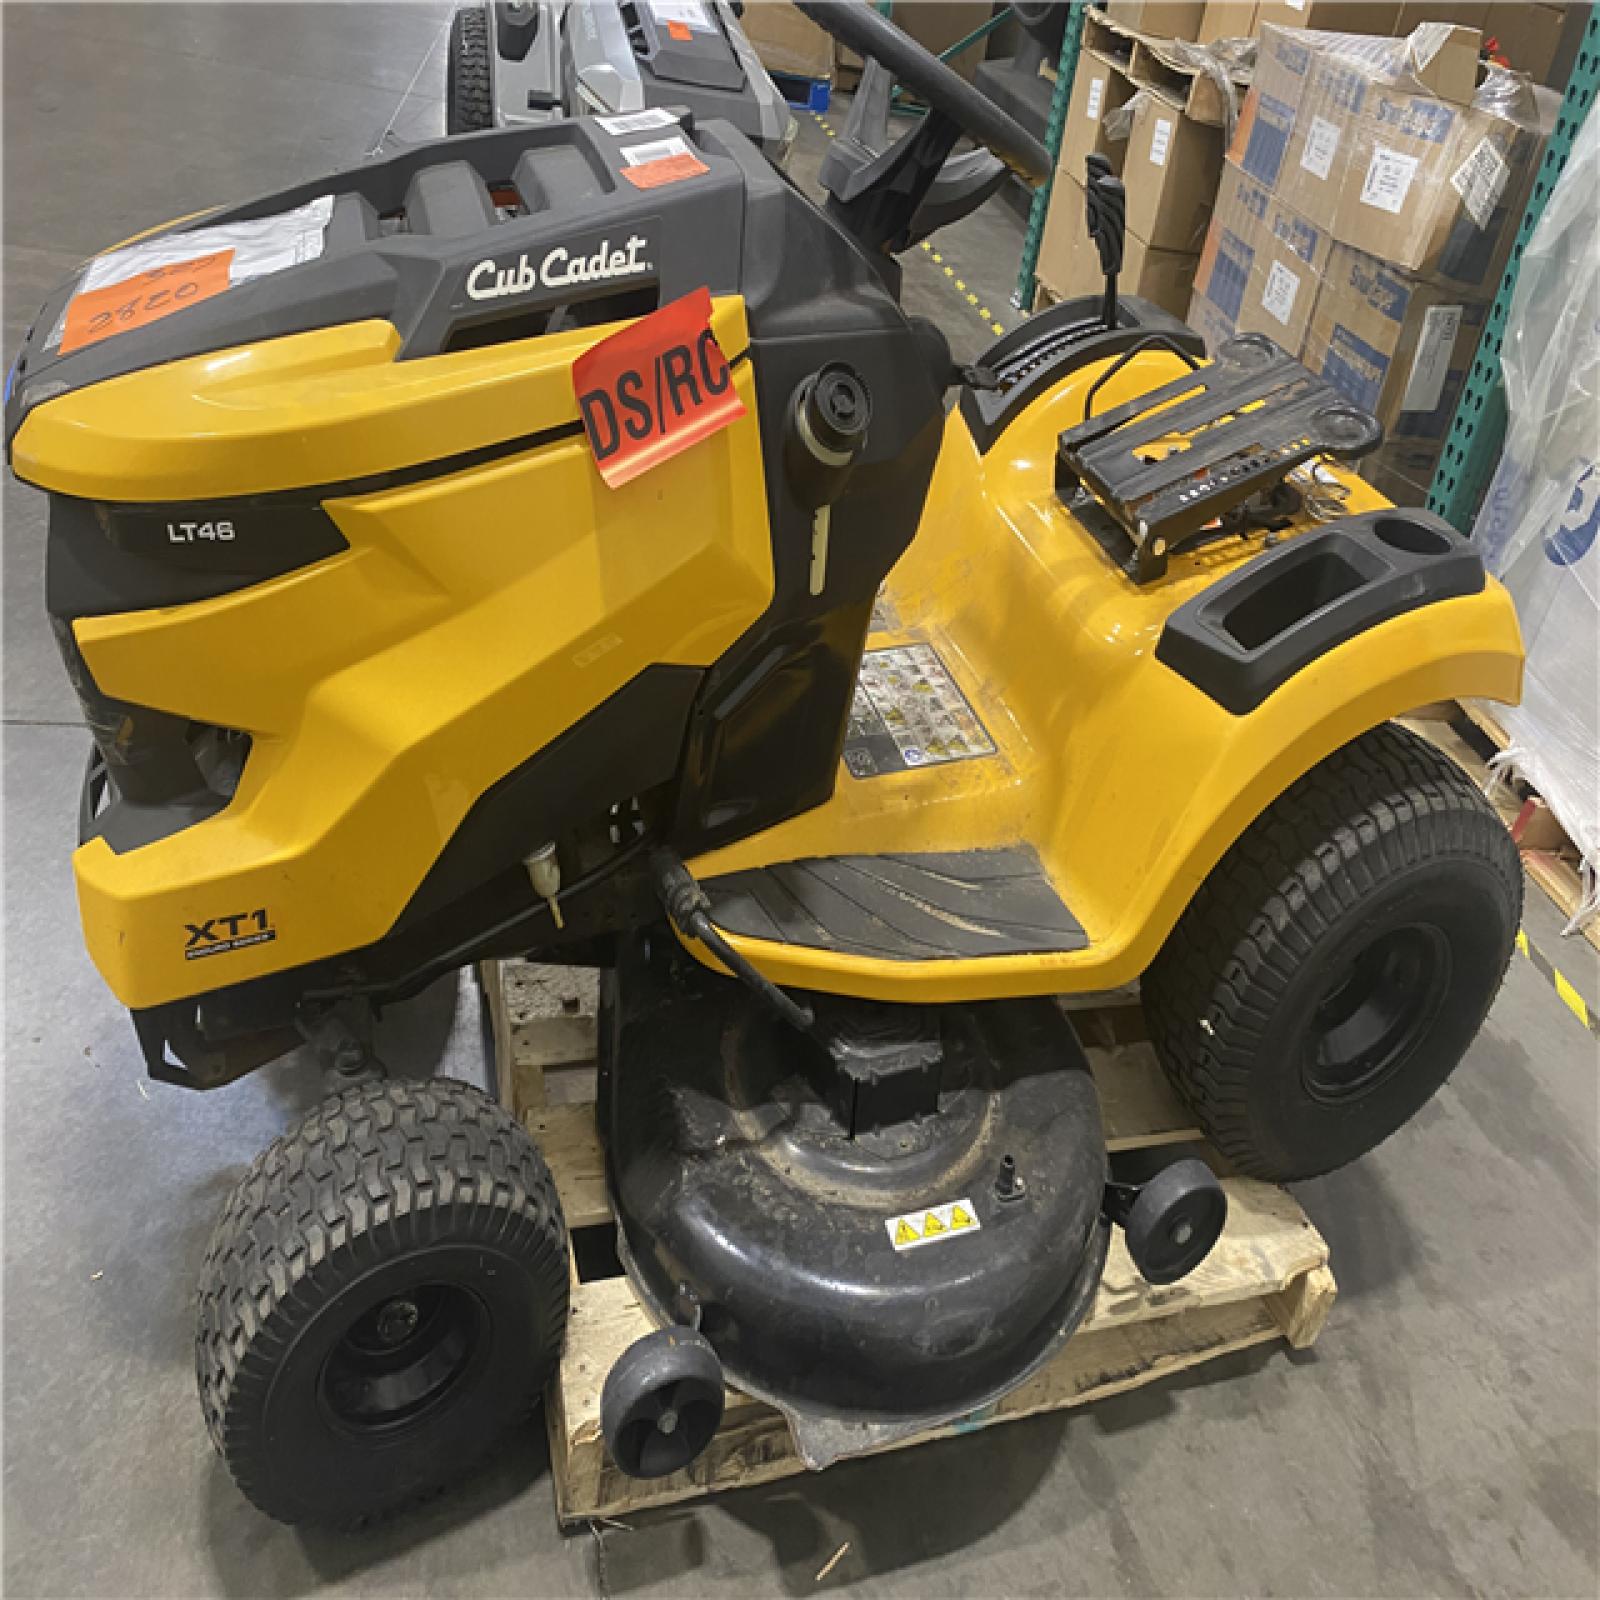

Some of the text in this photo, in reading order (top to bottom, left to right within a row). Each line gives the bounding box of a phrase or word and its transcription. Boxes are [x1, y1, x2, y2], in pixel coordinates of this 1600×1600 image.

[466, 235, 648, 300] Cub Cadet
[579, 328, 731, 461] DS/RC
[167, 521, 236, 543] LT46
[185, 909, 267, 947] XT1
